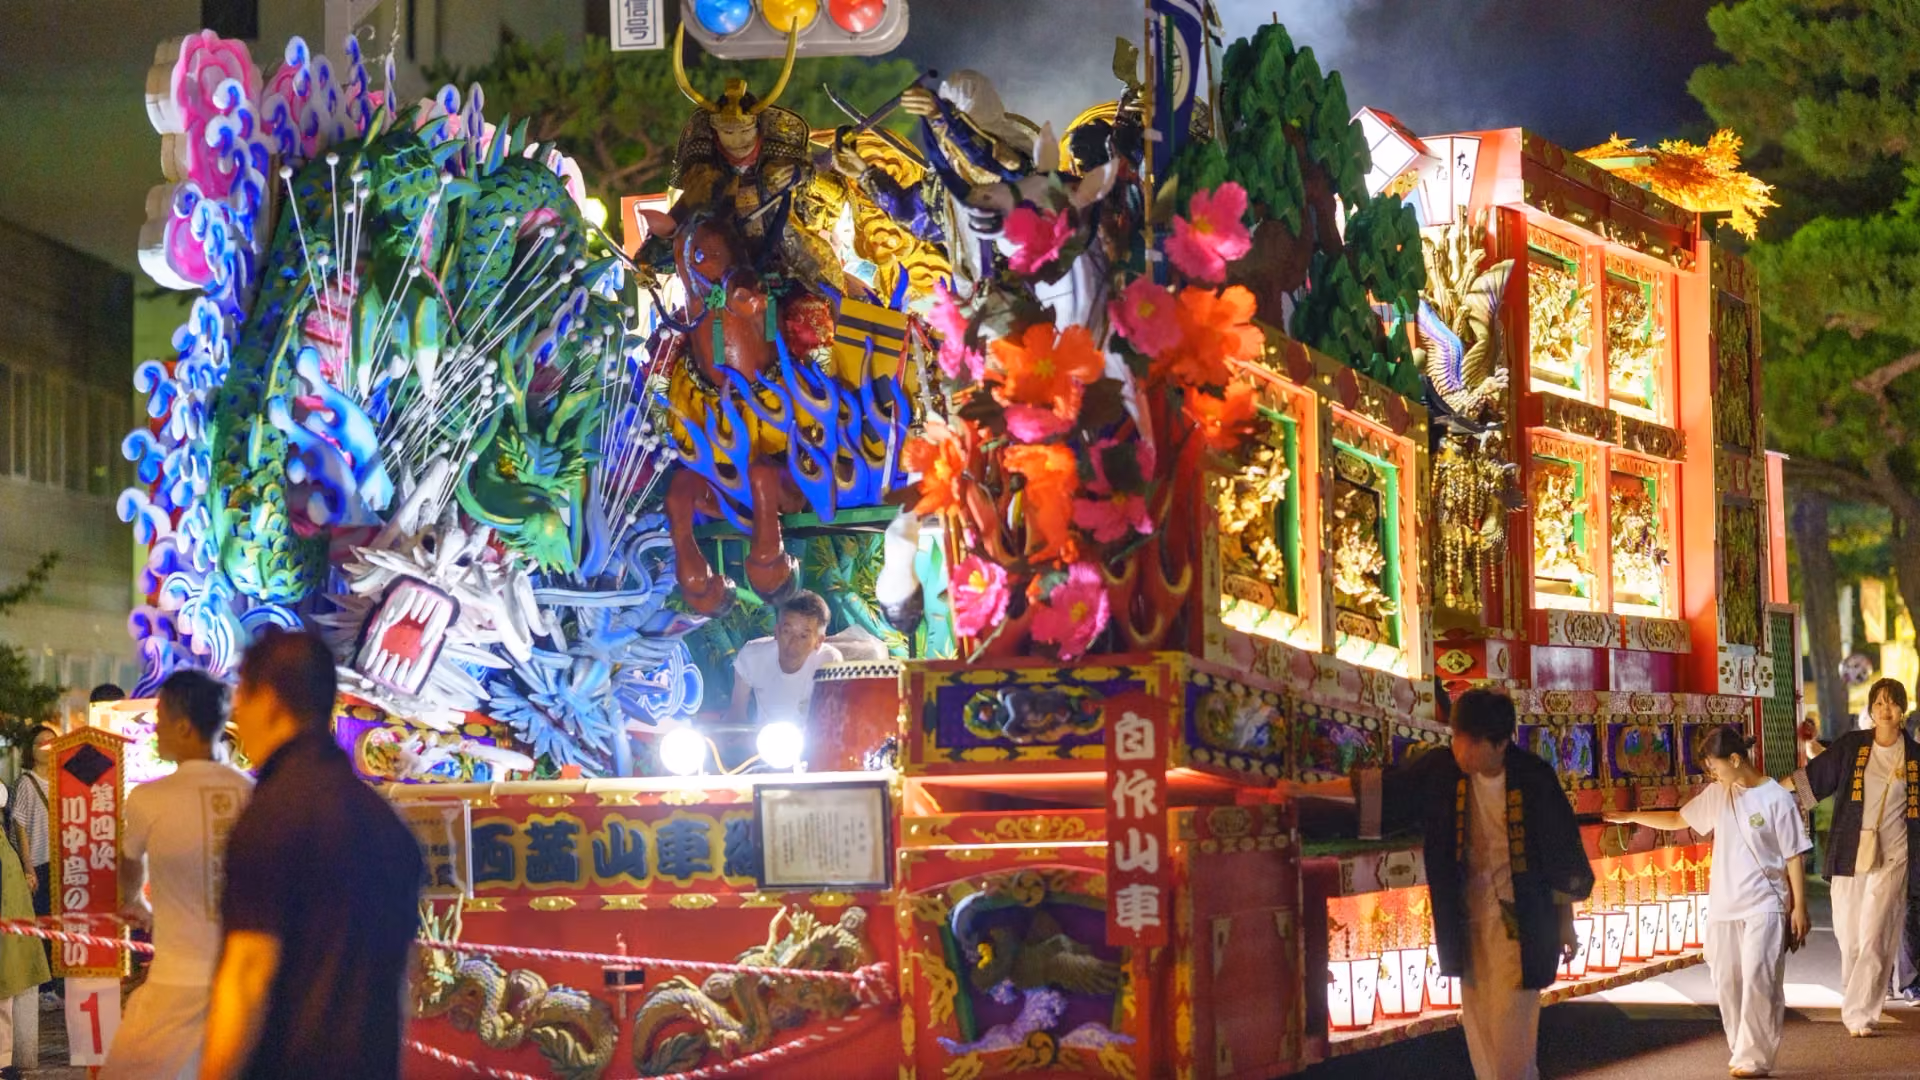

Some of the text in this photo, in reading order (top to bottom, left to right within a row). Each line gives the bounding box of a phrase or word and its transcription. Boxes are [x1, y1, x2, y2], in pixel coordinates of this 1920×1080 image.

[89, 784, 116, 871] 第四次
[1112, 711, 1160, 932] 自作山車
[80, 992, 102, 1055] 1
